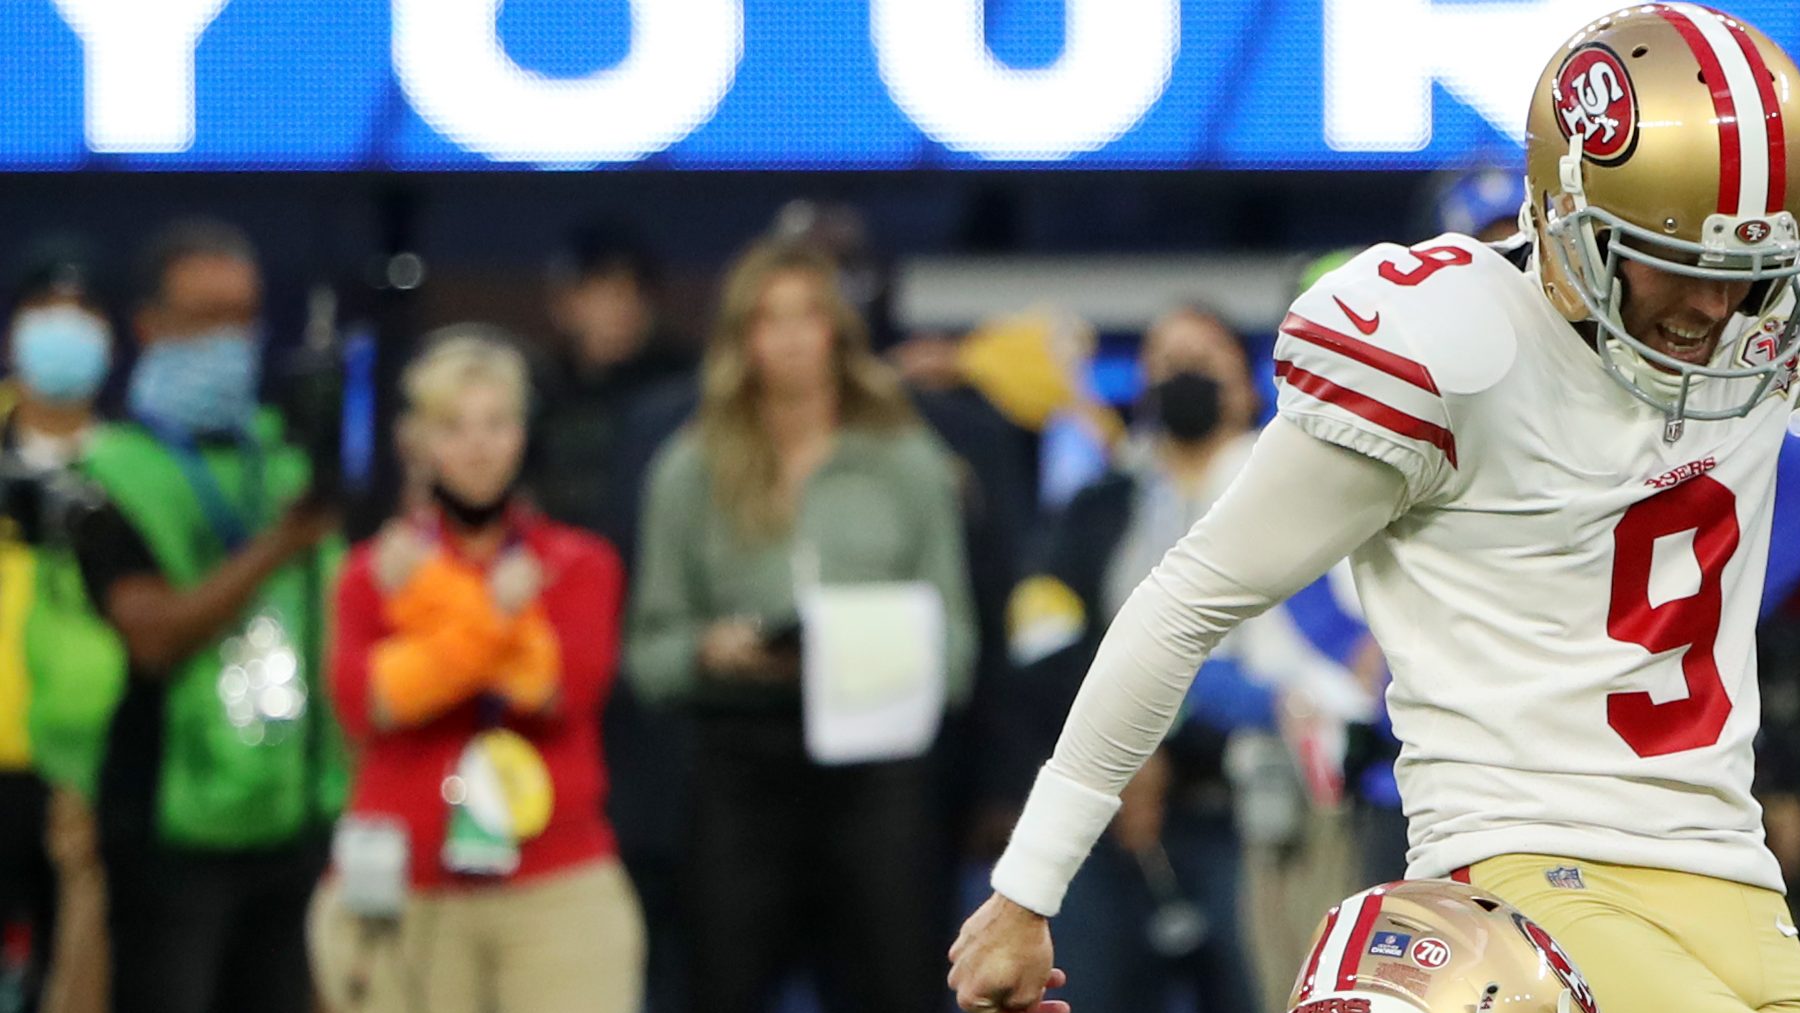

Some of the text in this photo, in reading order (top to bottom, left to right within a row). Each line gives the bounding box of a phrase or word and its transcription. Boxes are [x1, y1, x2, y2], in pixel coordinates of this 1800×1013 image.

[1378, 245, 1473, 286] 9
[1644, 456, 1716, 488] 49ERS
[1606, 474, 1740, 759] 9
[1416, 941, 1447, 966] 70
